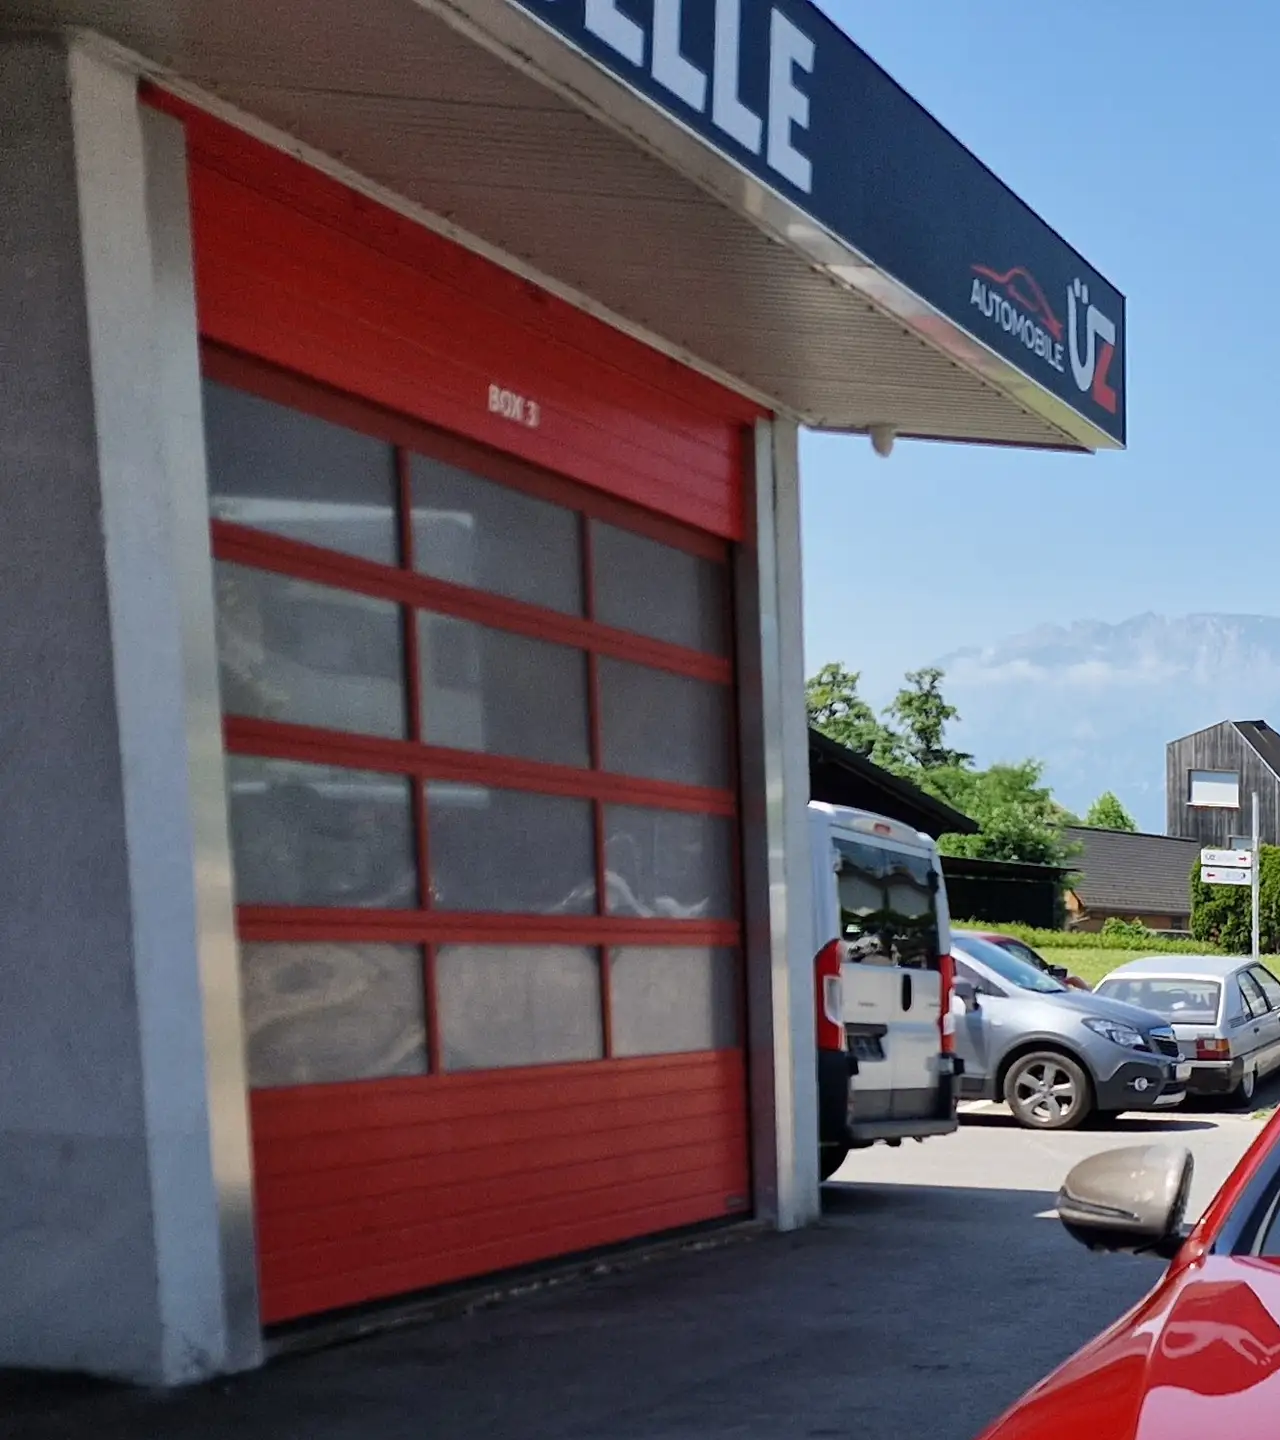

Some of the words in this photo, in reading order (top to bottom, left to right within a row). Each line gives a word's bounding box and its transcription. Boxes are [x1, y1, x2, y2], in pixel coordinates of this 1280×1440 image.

[585, 0, 815, 194] LLE
[488, 383, 524, 420] BOX
[525, 400, 541, 428] 3
[970, 278, 1065, 373] AUTOMOBILE
[1066, 277, 1117, 414] ÜZ
